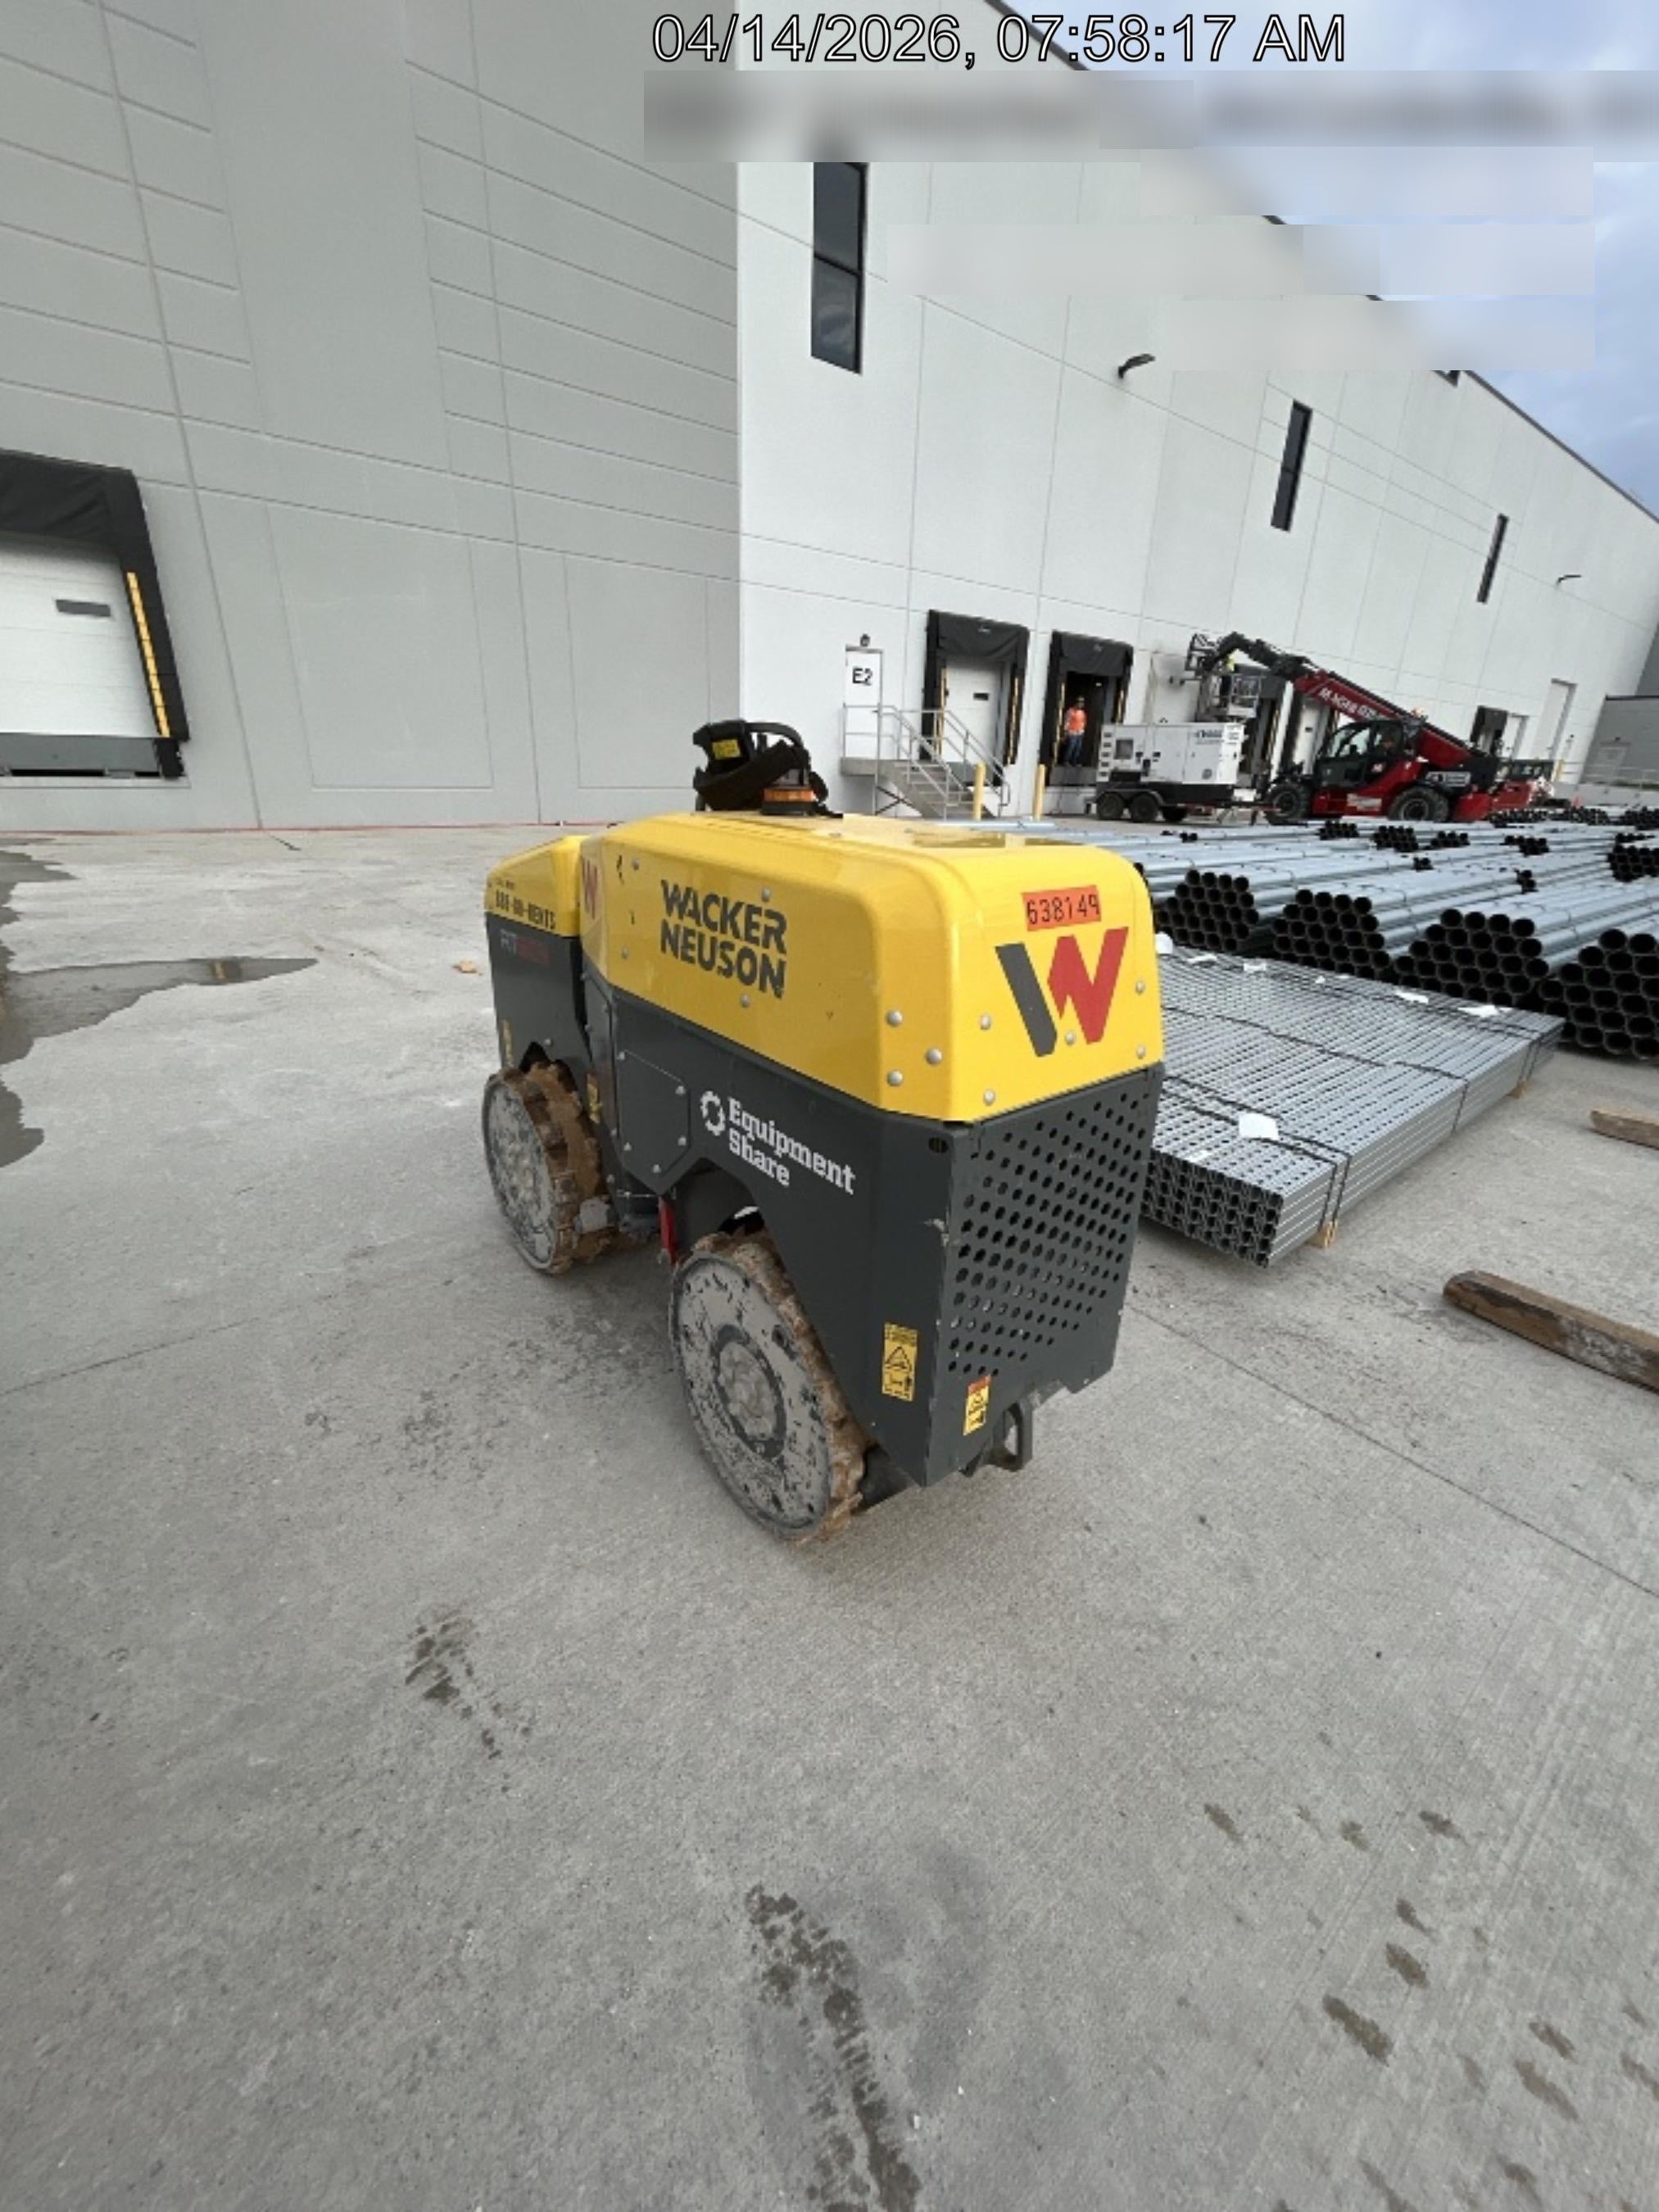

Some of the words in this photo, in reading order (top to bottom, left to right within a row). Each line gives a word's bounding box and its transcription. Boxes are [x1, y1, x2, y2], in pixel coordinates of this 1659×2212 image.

[851, 667, 873, 686] E2
[660, 879, 787, 956] WACKER
[1026, 894, 1099, 925] 638149
[660, 918, 787, 999] NEUSON
[728, 1096, 856, 1195] Equipment
[728, 1127, 790, 1186] Share
